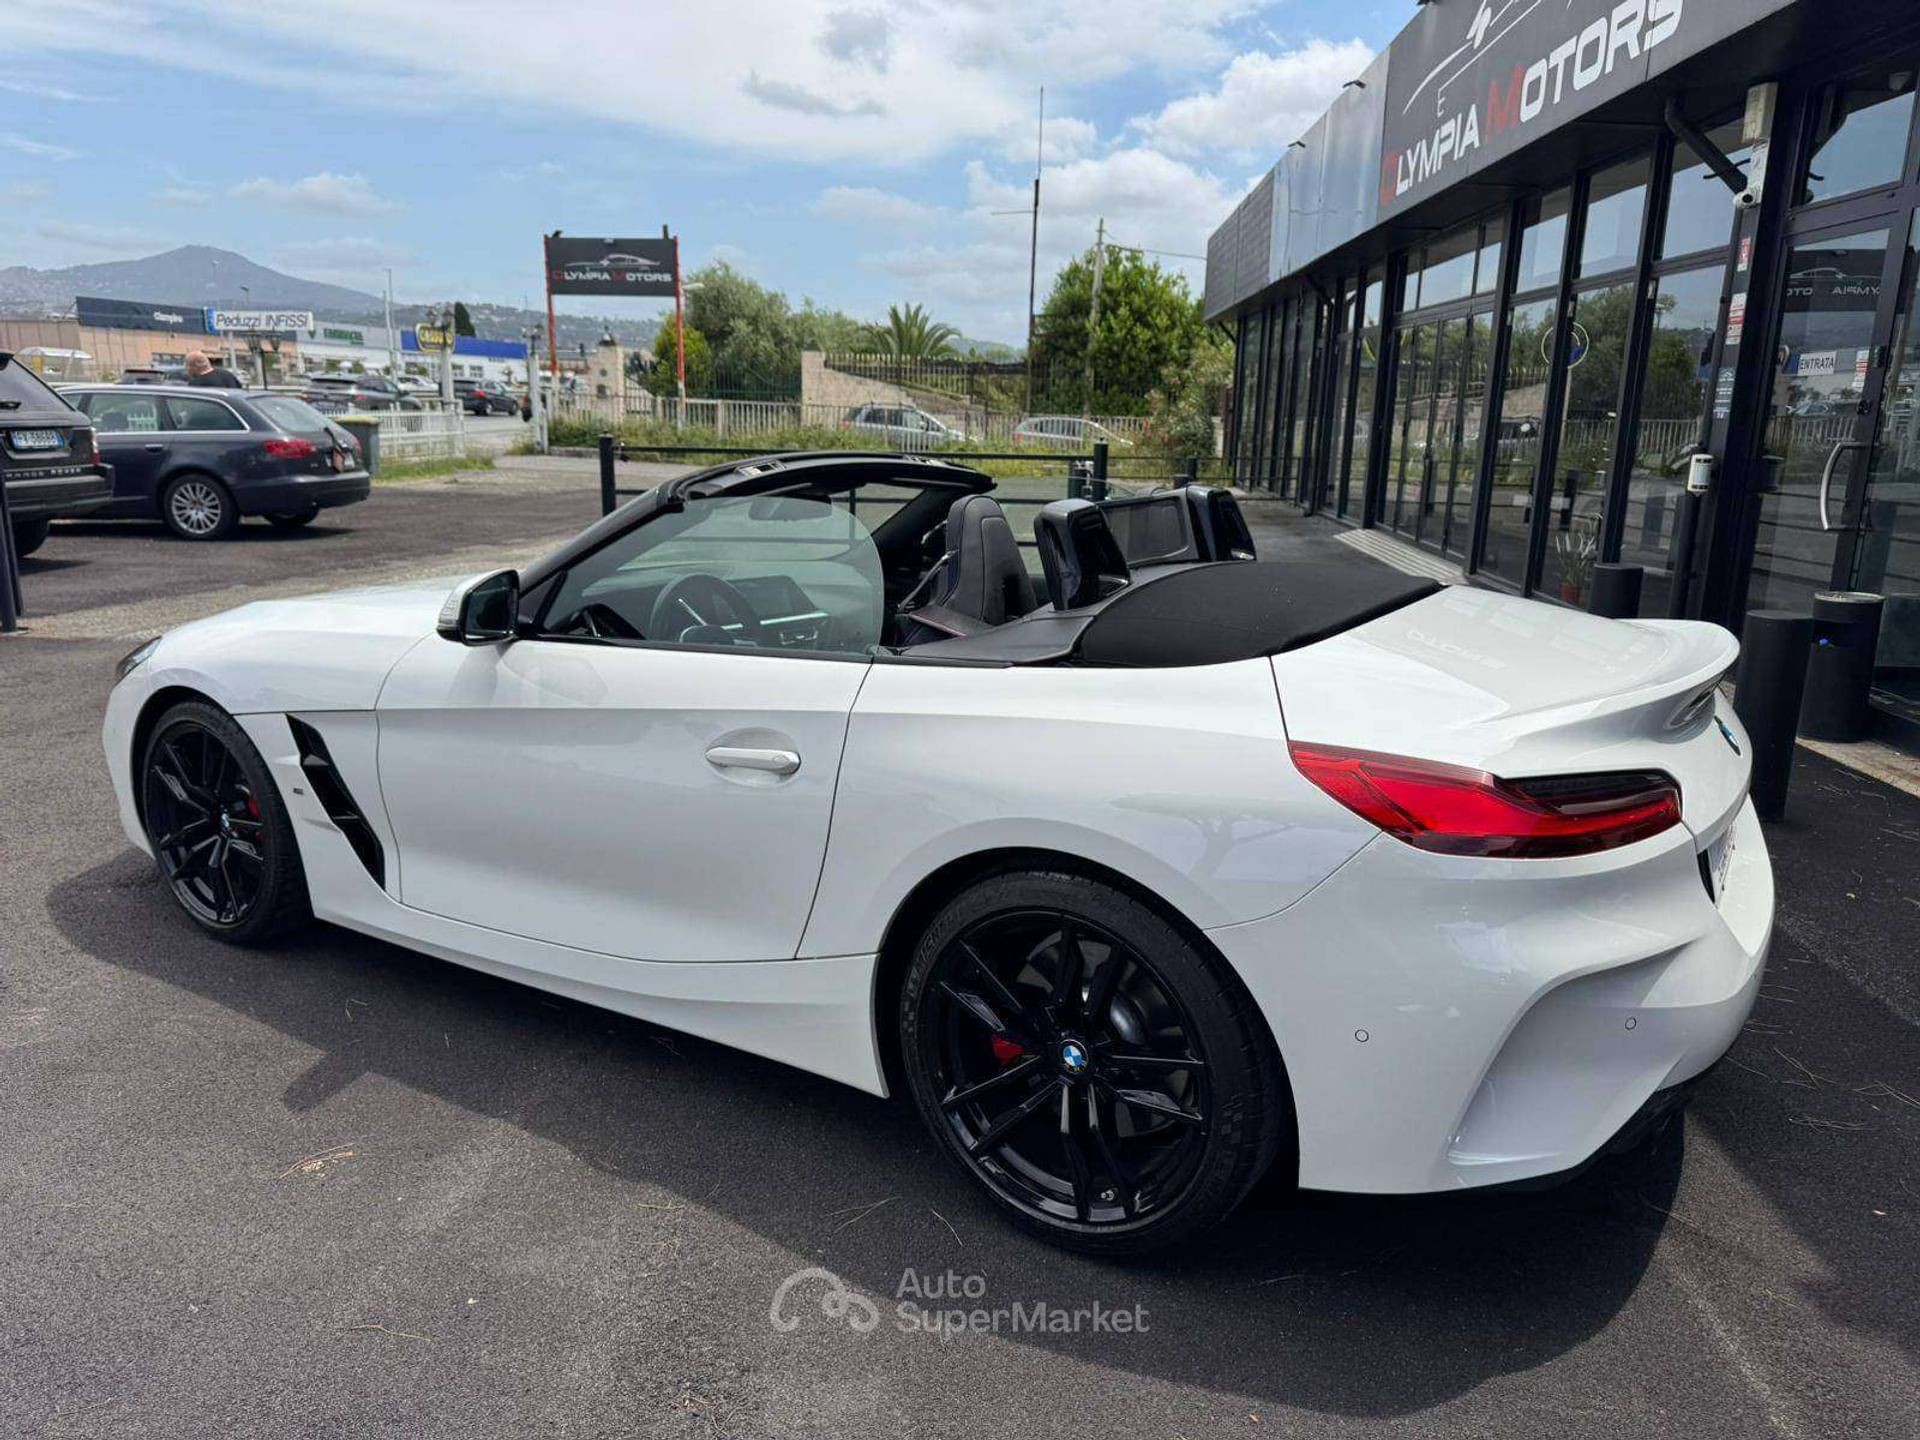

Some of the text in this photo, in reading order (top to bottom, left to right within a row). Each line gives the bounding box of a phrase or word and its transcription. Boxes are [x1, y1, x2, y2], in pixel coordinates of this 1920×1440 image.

[1380, 0, 1684, 207] OLYMPIA MOTORS
[216, 313, 261, 328] Peduzzi
[1800, 356, 1835, 371] ENTRATA
